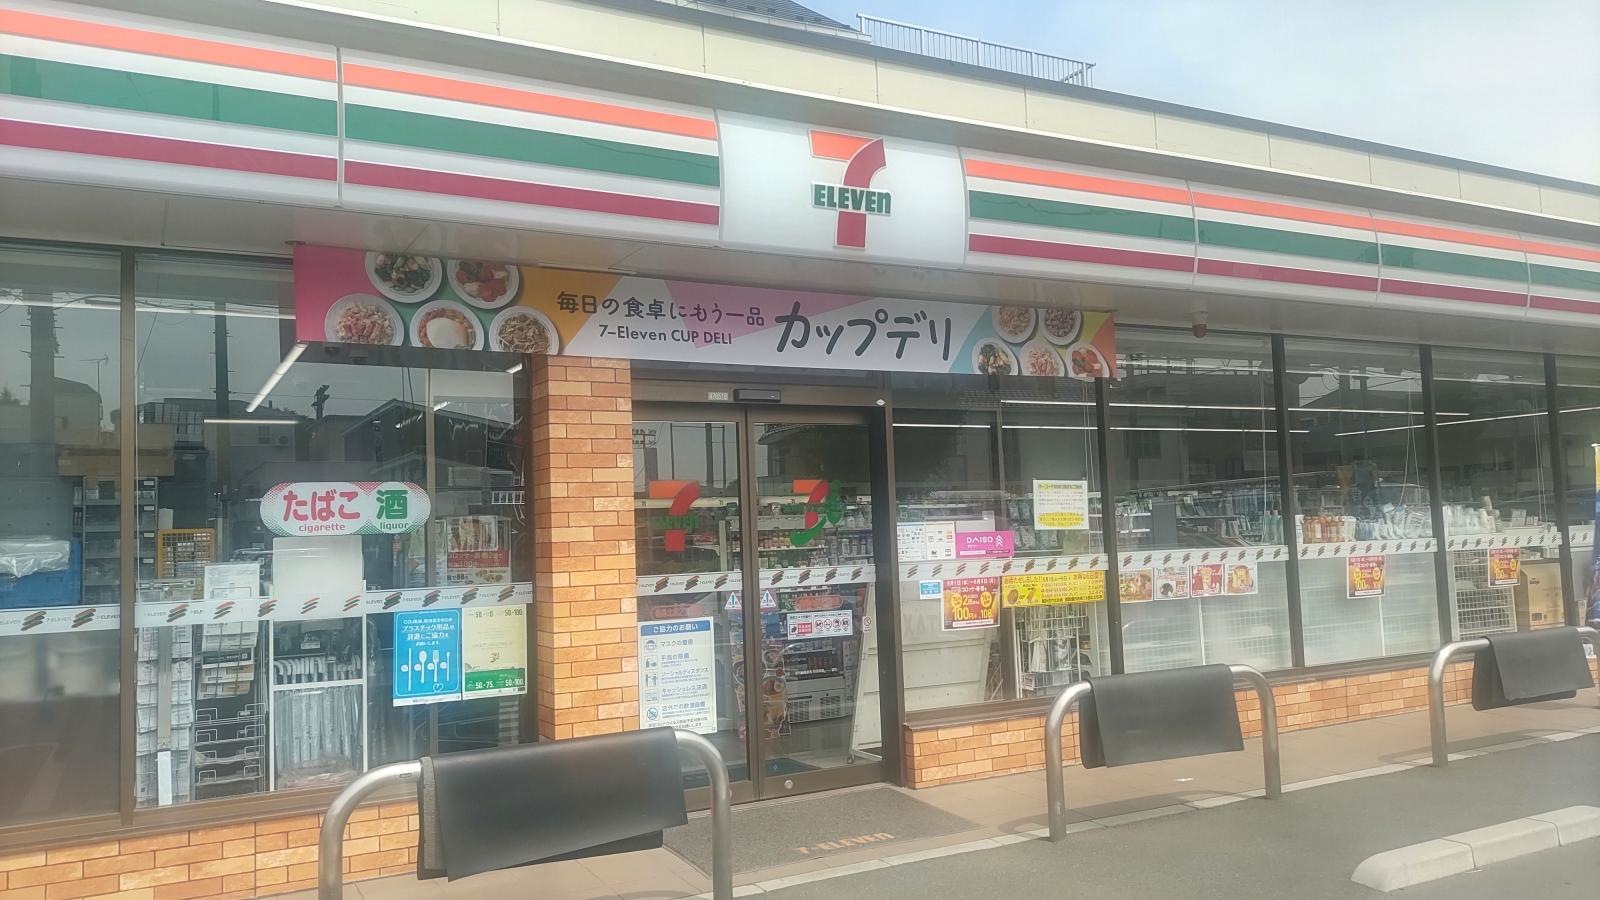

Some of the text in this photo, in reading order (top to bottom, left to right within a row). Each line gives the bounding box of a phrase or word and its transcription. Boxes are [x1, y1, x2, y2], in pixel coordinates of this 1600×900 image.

[808, 129, 887, 250] 7
[557, 290, 765, 327] 毎日の食卓にもう一品
[671, 329, 700, 343] CUP
[703, 331, 733, 345] DELI
[774, 300, 951, 360] カップデリ
[283, 489, 408, 521] たばこ 酒
[298, 522, 410, 533] cigarette liquor
[966, 536, 994, 544] DAISO
[653, 623, 698, 633] ご協力のお願い
[661, 667, 709, 677] ソーシャルディスタンス
